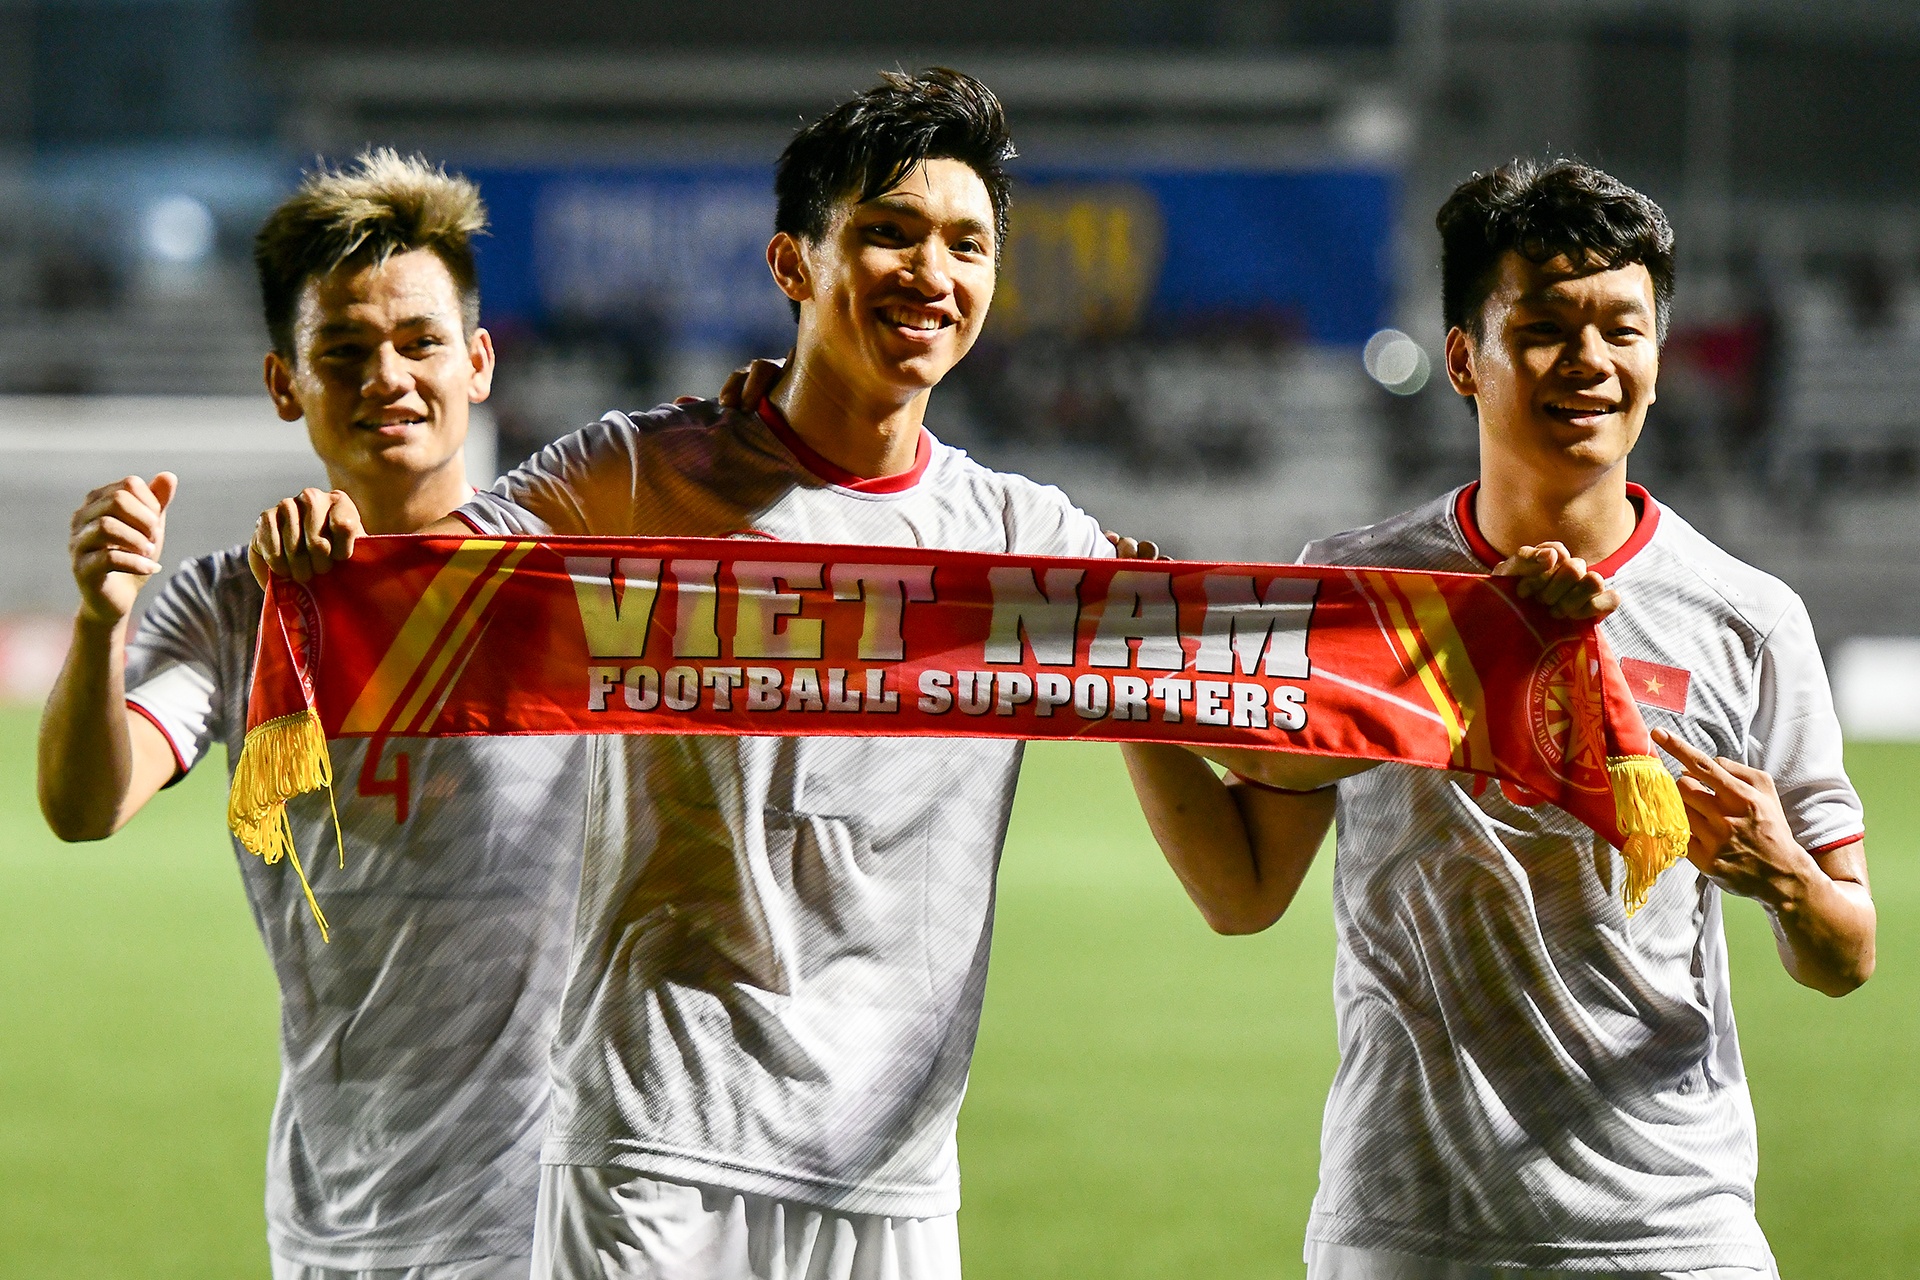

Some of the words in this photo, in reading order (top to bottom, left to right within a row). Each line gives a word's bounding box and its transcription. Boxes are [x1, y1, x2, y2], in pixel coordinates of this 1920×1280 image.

[564, 556, 936, 660] VIET
[984, 566, 1321, 679] NAM
[587, 665, 899, 713] FOOTBALL
[917, 669, 1308, 731] SUPPORTERS
[357, 735, 410, 825] 4
